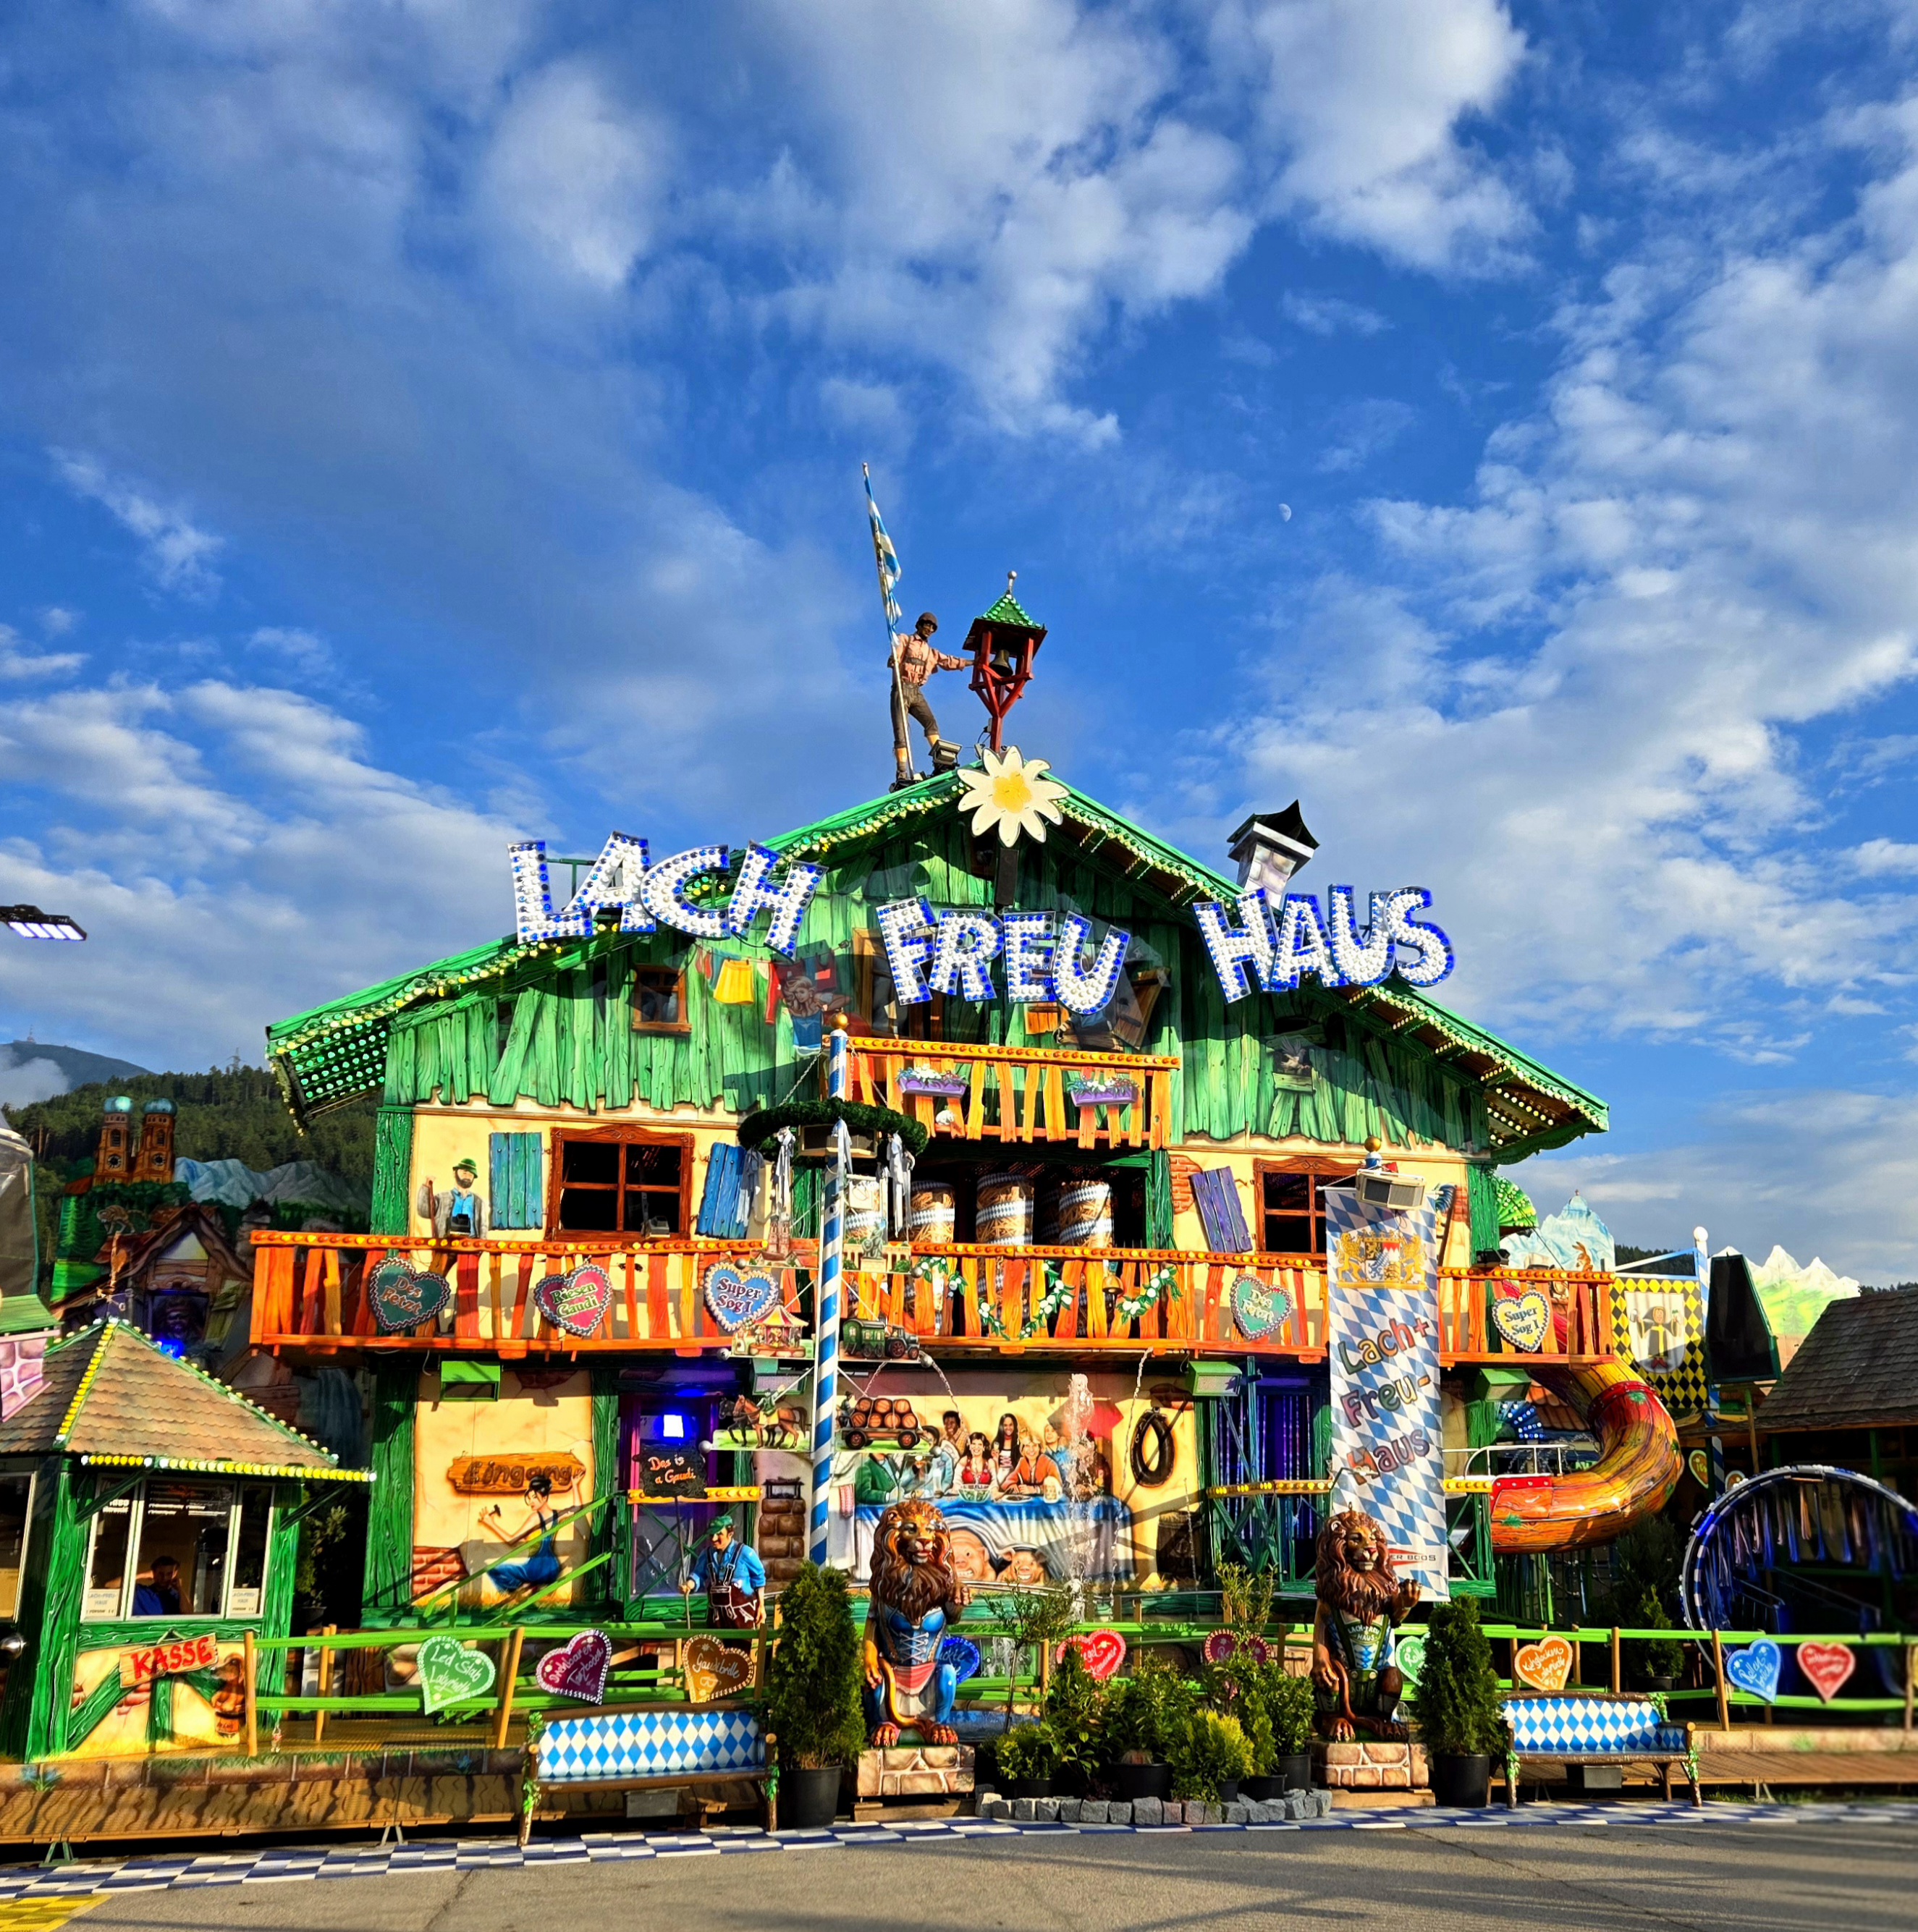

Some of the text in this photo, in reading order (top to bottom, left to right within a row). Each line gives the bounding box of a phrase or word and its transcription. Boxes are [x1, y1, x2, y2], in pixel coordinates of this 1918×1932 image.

[507, 831, 1456, 1014] LACH FREU HAUS
[549, 1283, 598, 1305] Riesen
[717, 1277, 762, 1300] Super
[557, 1295, 600, 1318] Gaudi
[717, 1293, 744, 1314] Sog
[1504, 1307, 1537, 1322] Super
[1511, 1323, 1533, 1335] Sog
[1346, 1429, 1429, 1486] Haus
[462, 1461, 573, 1488] Eingang
[131, 1637, 212, 1680] KASSE
[430, 1644, 483, 1683] Led Stab
